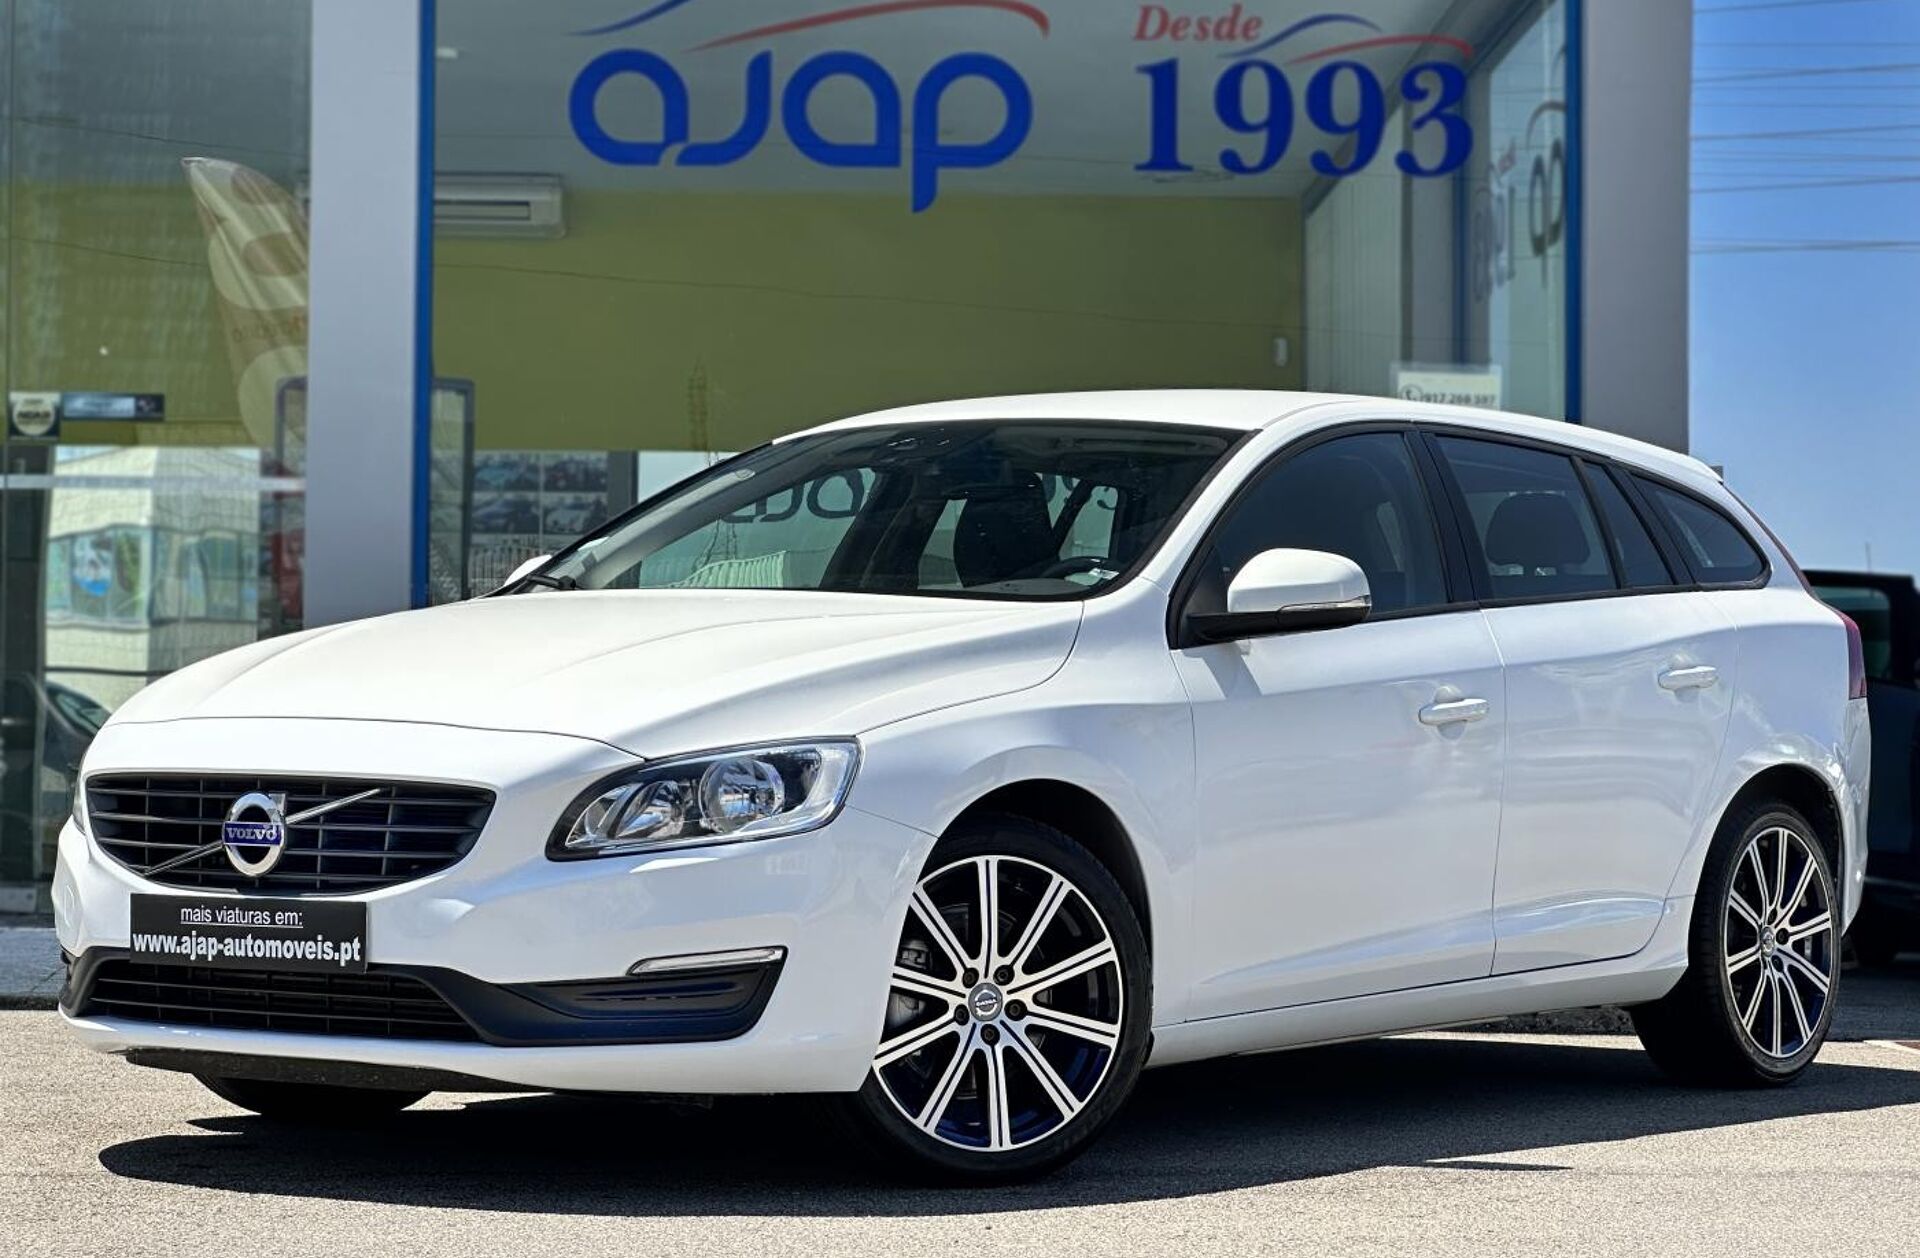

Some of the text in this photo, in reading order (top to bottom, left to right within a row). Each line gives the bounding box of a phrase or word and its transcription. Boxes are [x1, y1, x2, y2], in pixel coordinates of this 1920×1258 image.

[1133, 4, 1263, 42] Desde
[1133, 57, 1474, 178] 1993
[226, 826, 278, 841] VOLVO
[180, 905, 303, 926] mais viaturas em:
[132, 930, 361, 967] www.ajap-automoveis.pt
